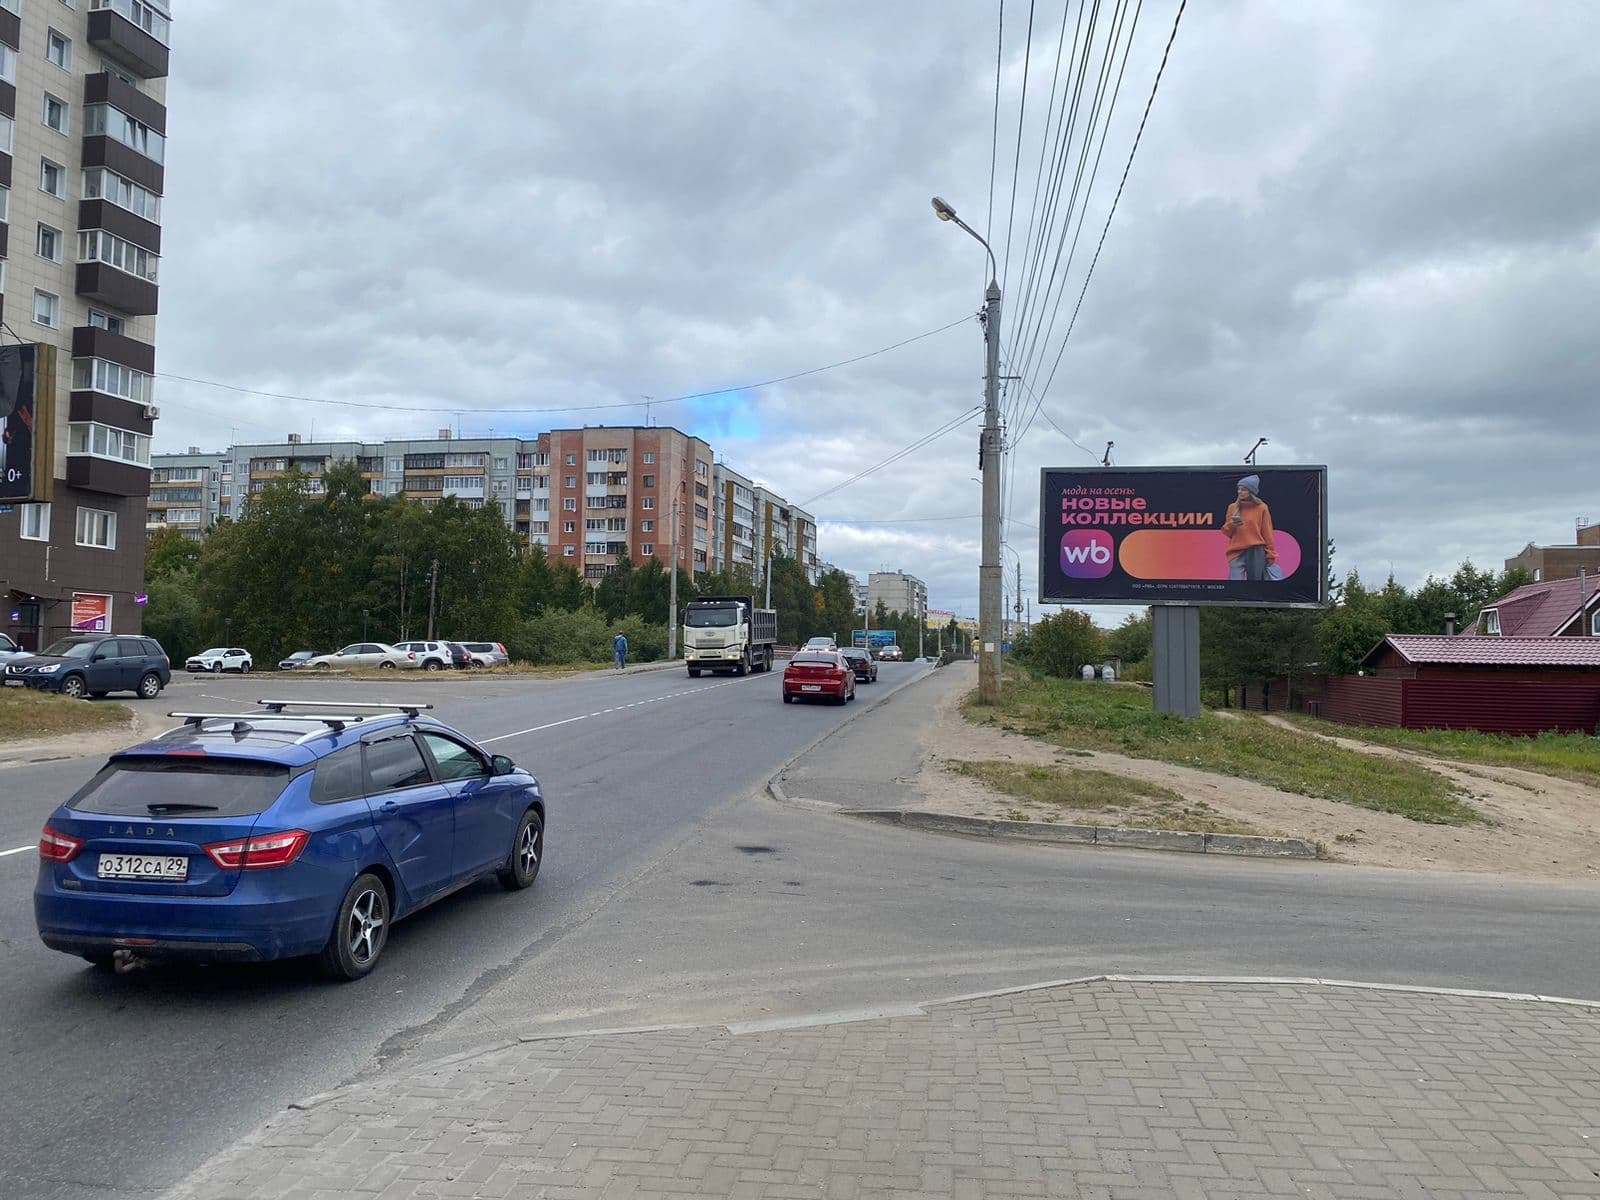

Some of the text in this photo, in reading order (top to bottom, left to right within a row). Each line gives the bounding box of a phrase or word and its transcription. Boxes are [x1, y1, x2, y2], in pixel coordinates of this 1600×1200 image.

[7, 468, 22, 482] 0+
[1061, 485, 1087, 495] мода
[1104, 488, 1136, 496] осень:
[1061, 497, 1147, 510] новые
[1061, 512, 1213, 527] коллекции
[1063, 539, 1111, 564] wb
[108, 825, 174, 837] LADA
[166, 858, 183, 871] 29
